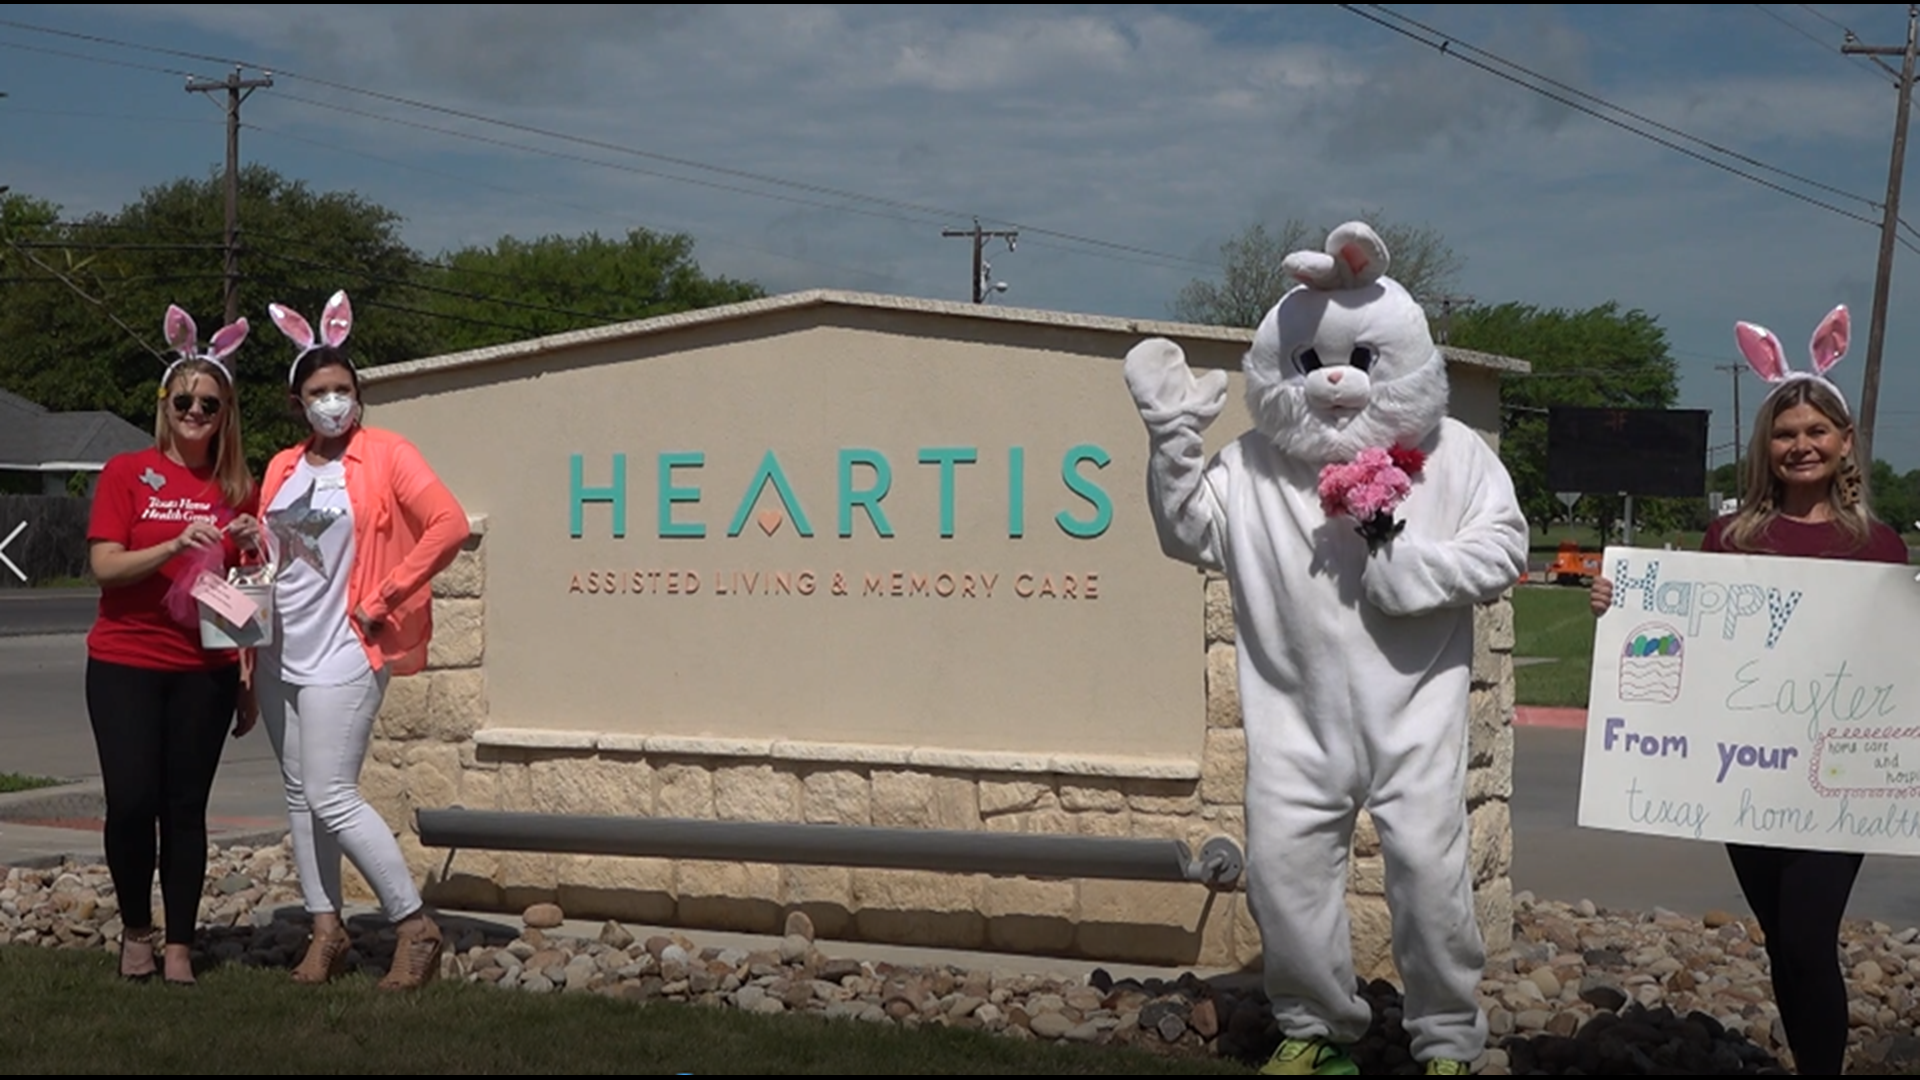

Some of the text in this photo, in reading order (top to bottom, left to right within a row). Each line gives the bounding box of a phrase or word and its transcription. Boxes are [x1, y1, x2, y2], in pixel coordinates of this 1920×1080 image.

[179, 498, 210, 511] Home
[569, 444, 1114, 539] HEARTIS
[142, 508, 181, 520] Health
[569, 571, 1099, 600] ASSISTED LIVING & MEMORY CARE
[1613, 559, 1802, 648] Happy
[1604, 718, 1798, 783] From your
[1828, 741, 1889, 755] home care
[1874, 752, 1899, 769] and
[1734, 788, 1818, 834] home
